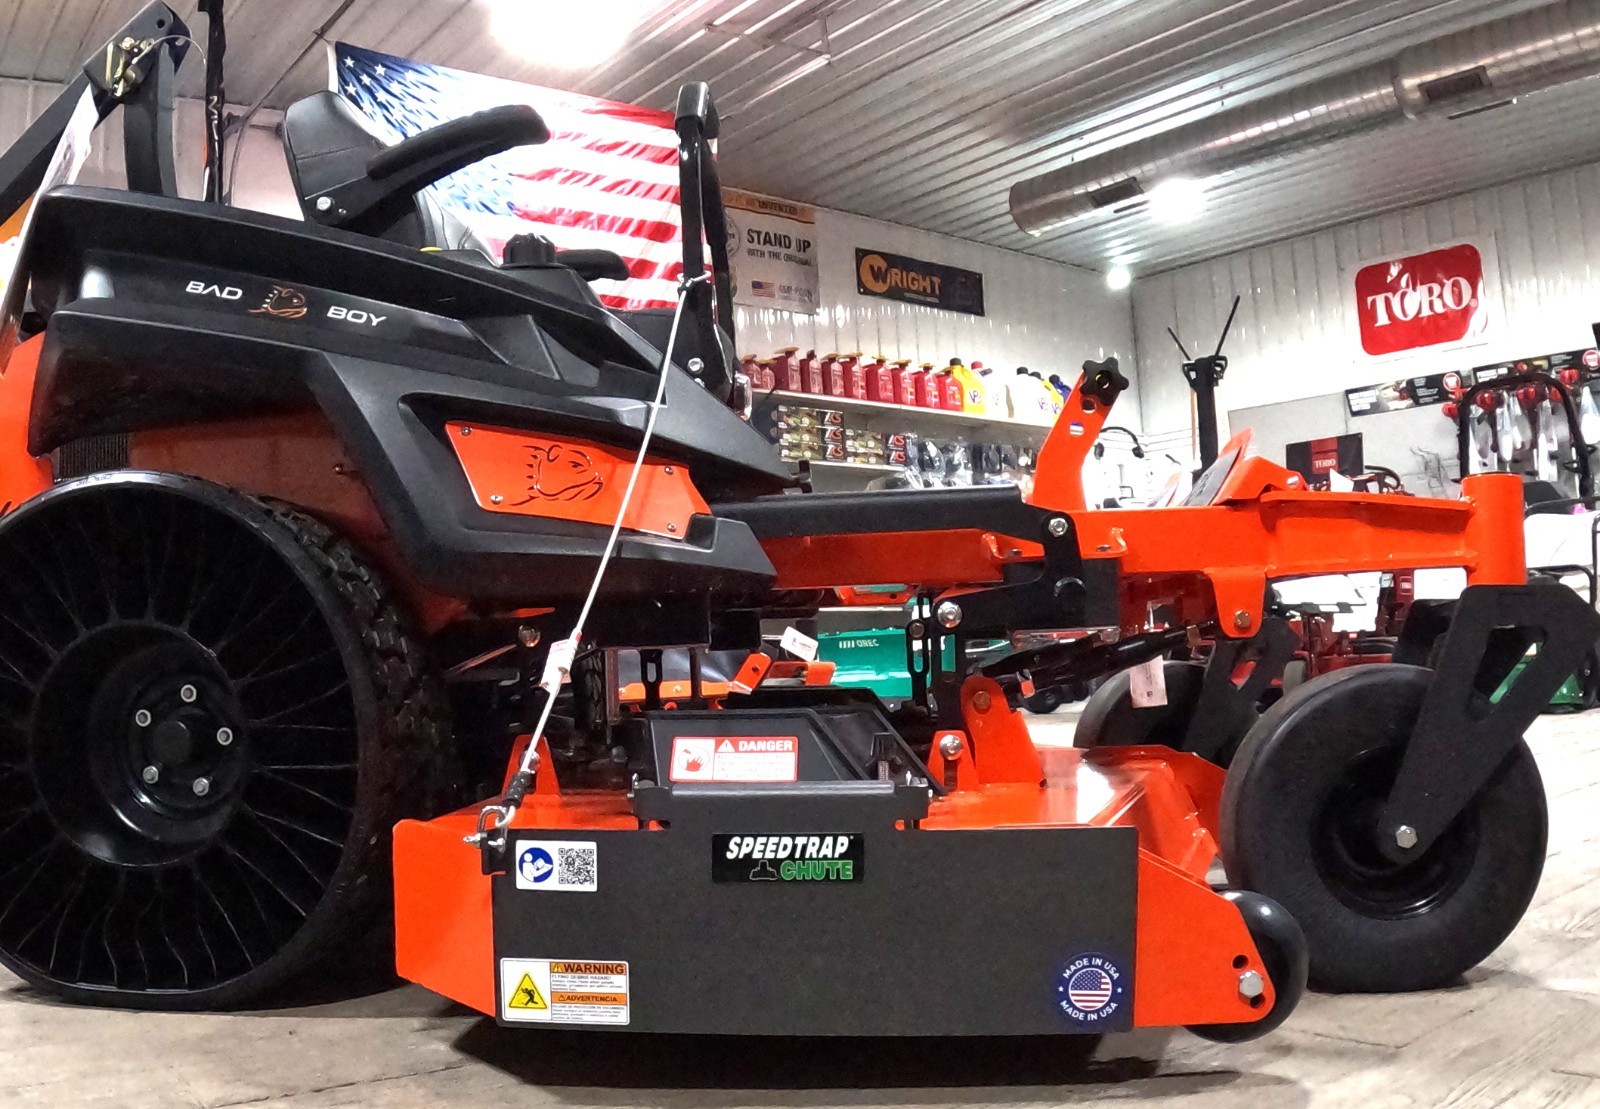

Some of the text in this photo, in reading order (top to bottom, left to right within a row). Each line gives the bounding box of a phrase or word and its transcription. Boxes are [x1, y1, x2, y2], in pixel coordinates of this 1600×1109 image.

[747, 228, 792, 249] STAND
[795, 237, 812, 253] UP
[747, 248, 766, 258] WITH
[768, 250, 782, 260] THE
[861, 254, 941, 296] WRIGHT
[185, 280, 387, 327] BAD BOY
[1366, 275, 1473, 327] TORO
[1314, 458, 1336, 469] TORO
[856, 639, 879, 648] OREC
[738, 740, 793, 752] DANGER
[726, 836, 850, 859] SPEEDTRAP
[780, 860, 853, 880] CHUTE
[564, 963, 624, 975] WARNING
[1062, 957, 1120, 980] MADE IN USA
[566, 994, 618, 1002] ADVERTENCIA
[1060, 1000, 1118, 1021] MADE IN USA
